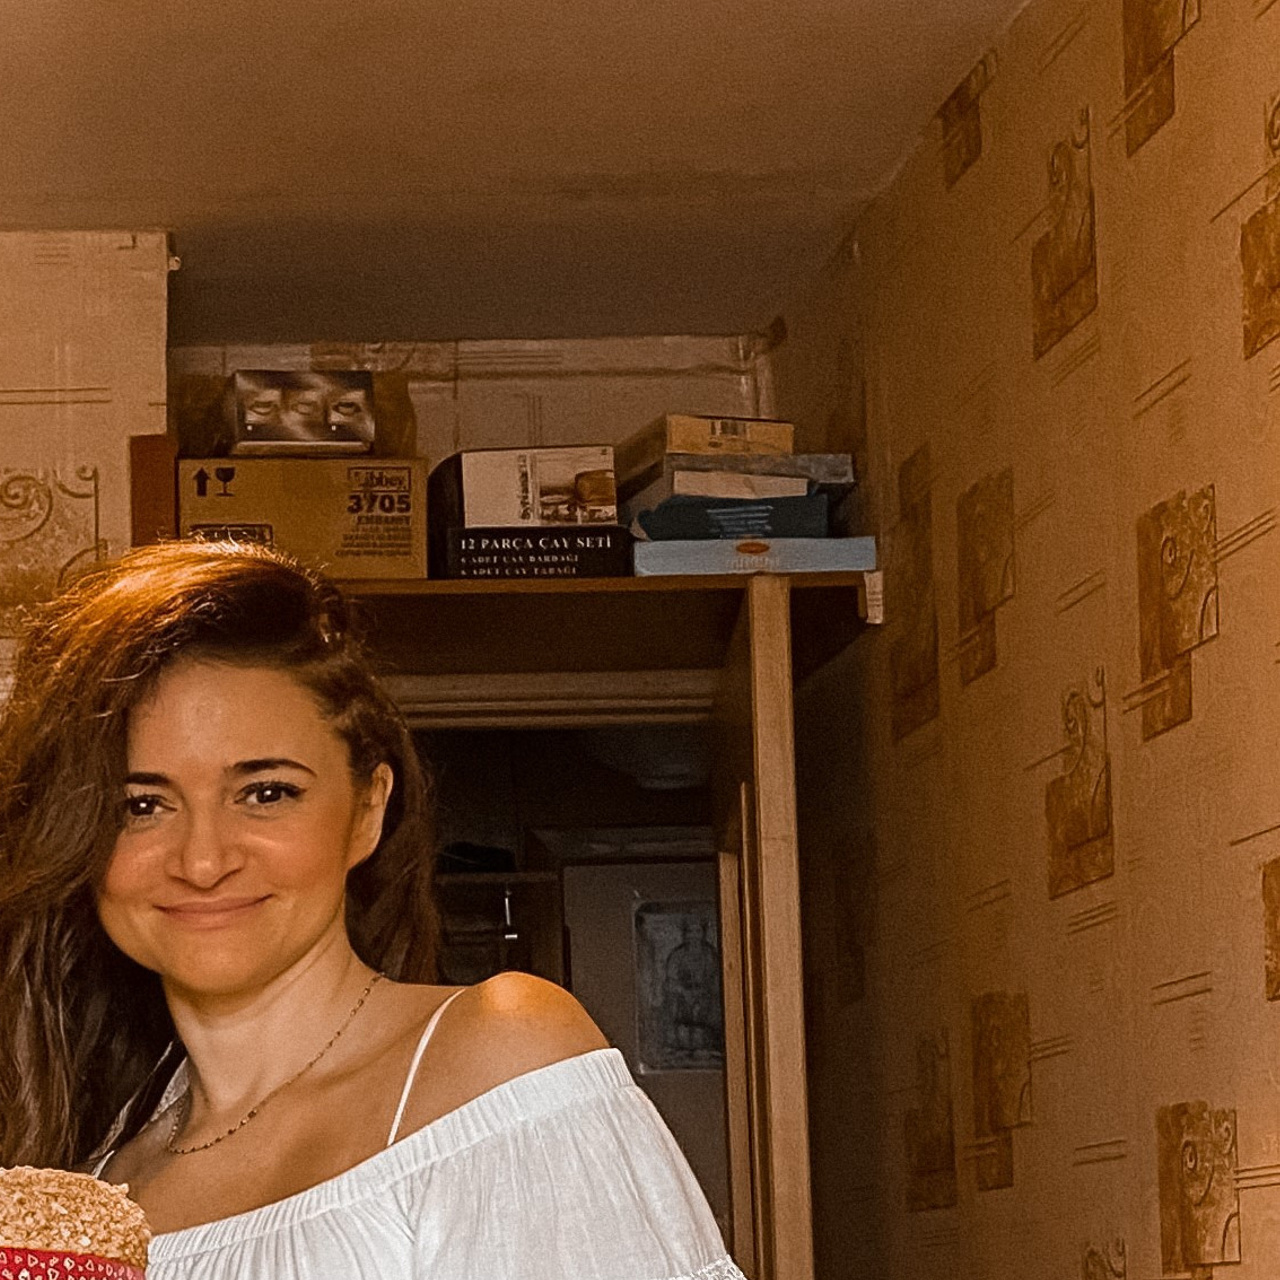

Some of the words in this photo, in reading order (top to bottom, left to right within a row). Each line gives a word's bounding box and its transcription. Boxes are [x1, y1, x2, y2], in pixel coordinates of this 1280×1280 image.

[347, 494, 411, 514] 3705
[461, 538, 475, 550] 12
[481, 538, 534, 550] PARÇA
[538, 537, 570, 550] ÇAY
[576, 534, 612, 549] SETİ
